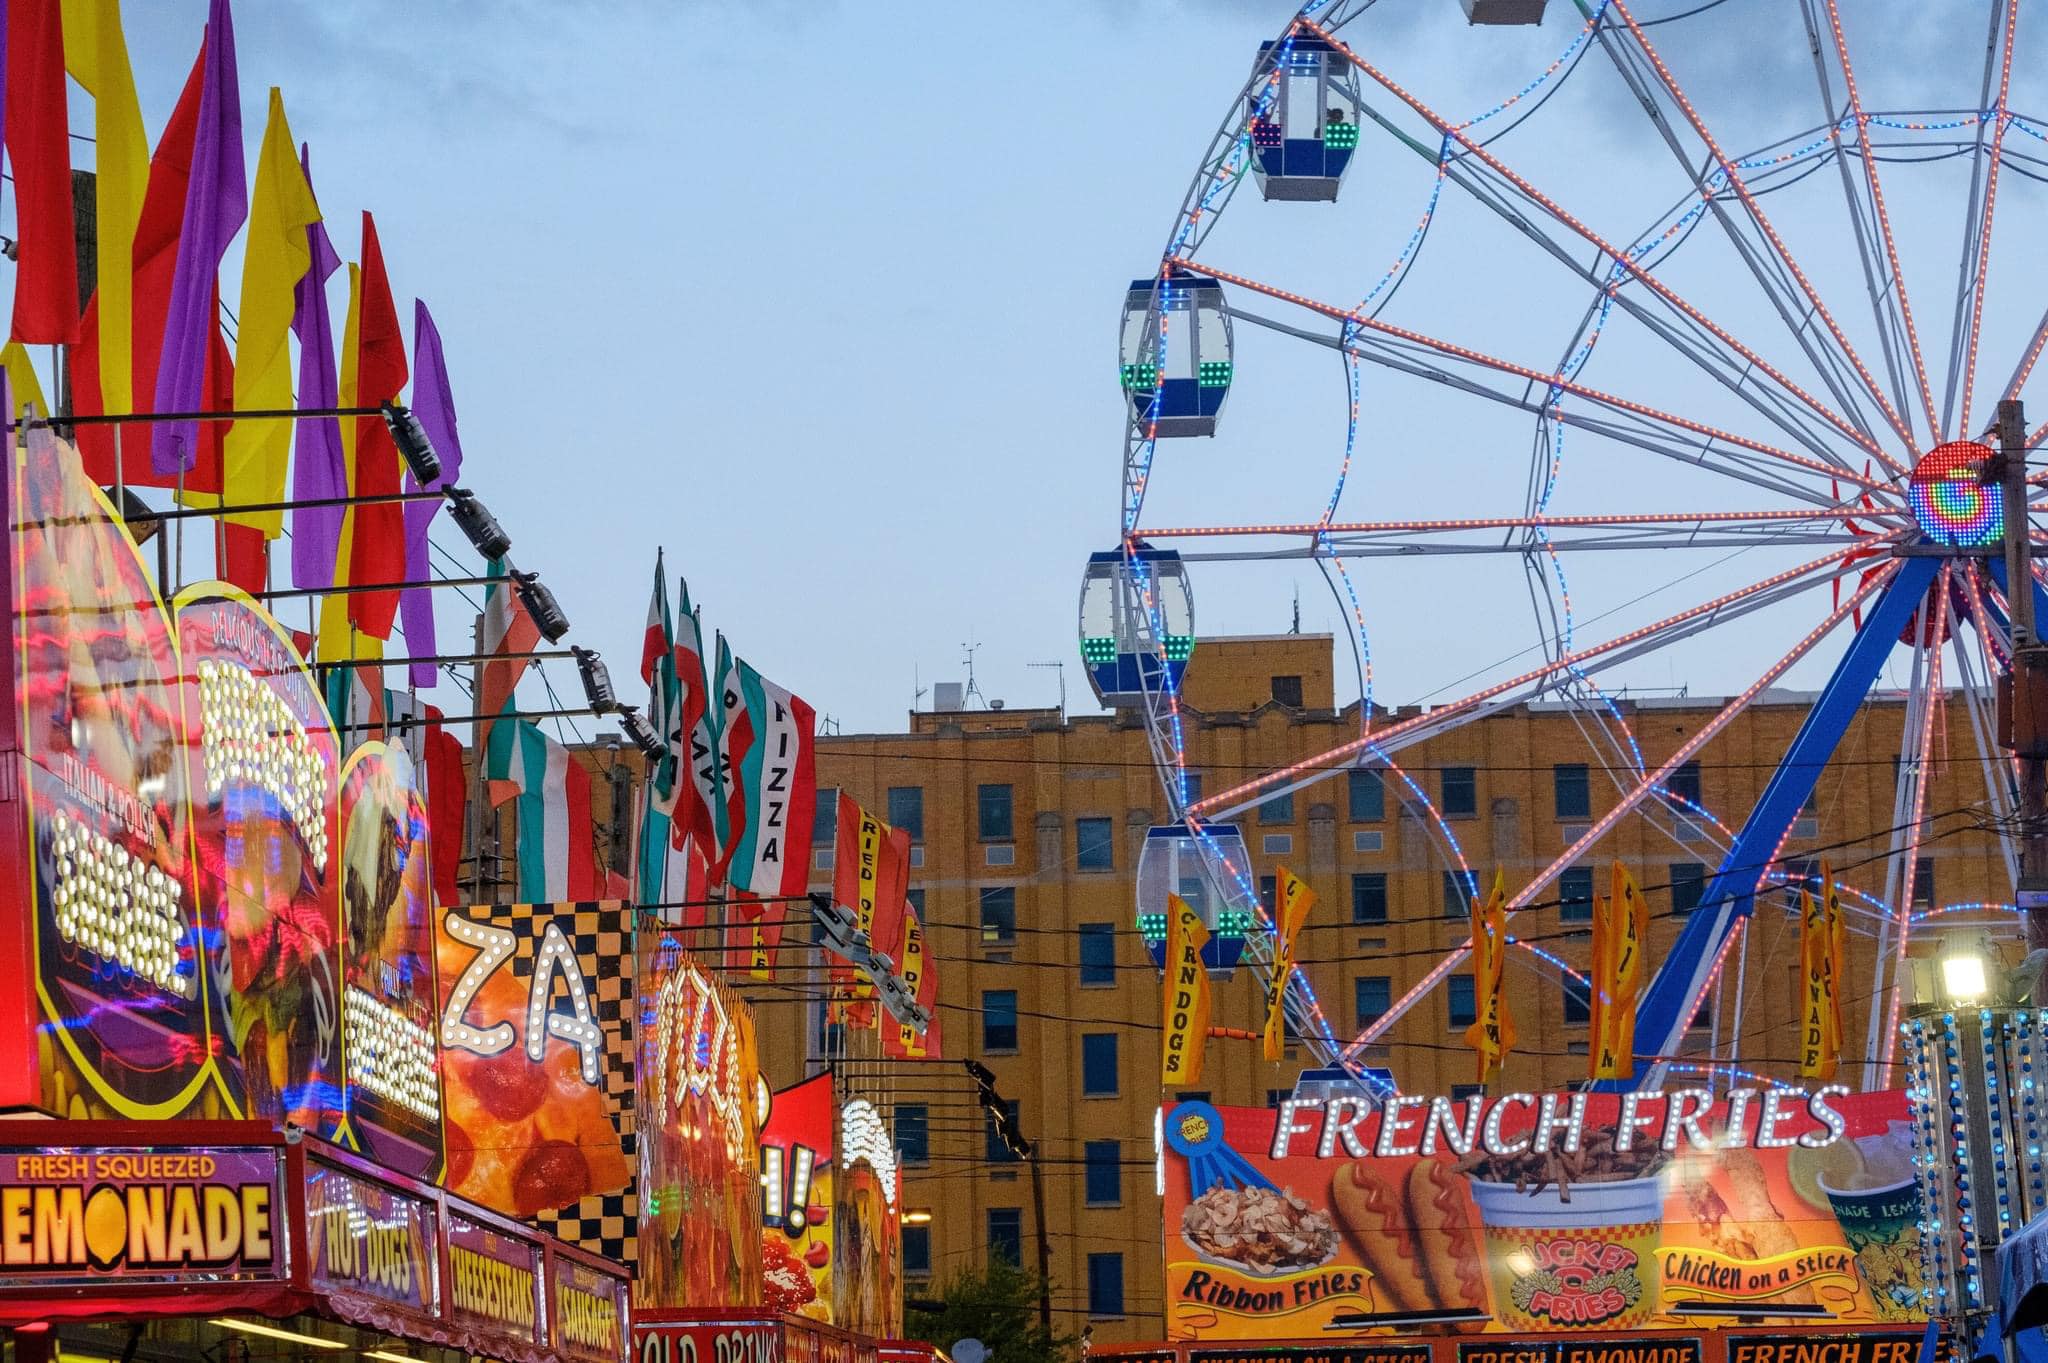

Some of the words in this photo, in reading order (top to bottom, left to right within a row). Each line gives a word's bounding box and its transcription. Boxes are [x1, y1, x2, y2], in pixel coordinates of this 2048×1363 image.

[63, 752, 106, 817] ITALIAN
[117, 787, 158, 849] POLISH
[1165, 991, 1192, 1073] DOGS
[1270, 1092, 1588, 1159] FRENCH
[1613, 1084, 1850, 1151] FRIES
[17, 1155, 89, 1179] FRESH
[96, 1155, 216, 1179] SQUEEZED
[0, 1185, 272, 1265] EMONADE
[325, 1201, 366, 1279] HOT
[366, 1214, 411, 1296] DOGS
[1510, 1238, 1639, 1274] UCKET
[450, 1244, 535, 1329] CHEESESTEAKS
[1182, 1270, 1284, 1312] Ribbon
[1292, 1272, 1362, 1301] Fries
[1665, 1252, 1742, 1290] Chicken
[1749, 1272, 1772, 1290] on
[1778, 1267, 1790, 1284] a
[1796, 1252, 1850, 1277] Stick
[562, 1285, 613, 1350] SAUSAGE
[1529, 1286, 1627, 1324] FRIES
[1734, 1341, 1862, 1363] FRENCH
